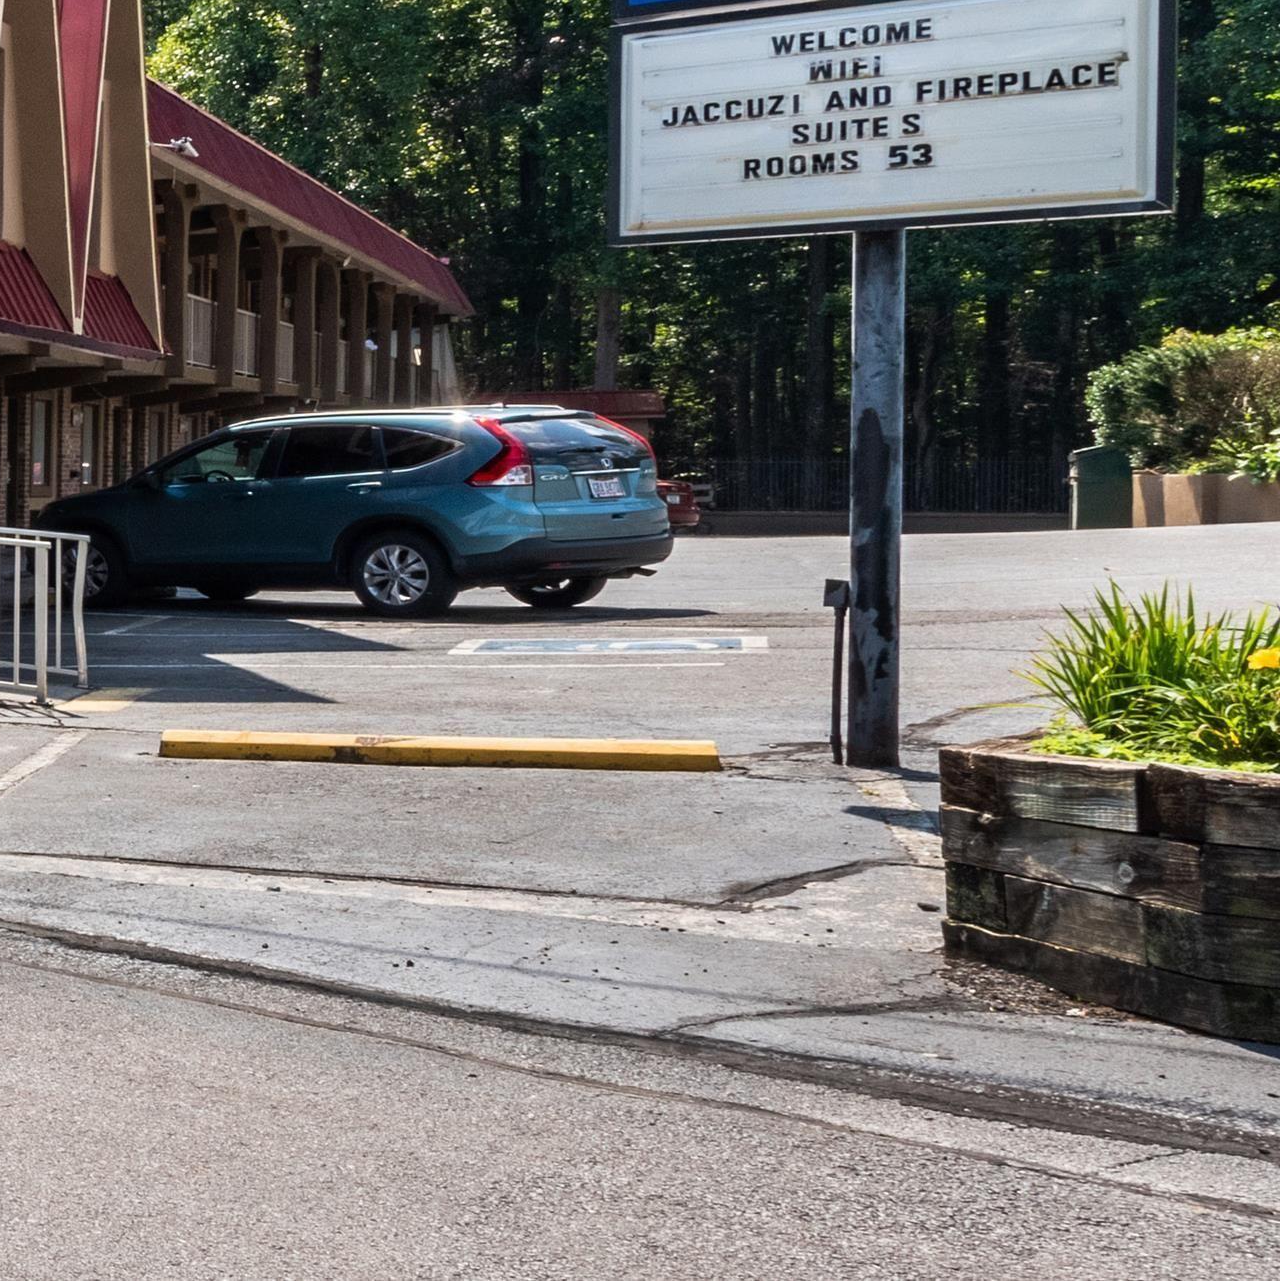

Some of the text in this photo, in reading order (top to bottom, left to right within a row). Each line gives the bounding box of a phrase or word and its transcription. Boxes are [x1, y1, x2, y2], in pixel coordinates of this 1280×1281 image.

[771, 17, 932, 56] WELCOME
[661, 61, 1117, 128] JACCUZI AND FIREPLACE
[742, 143, 934, 180] ROOMS 53
